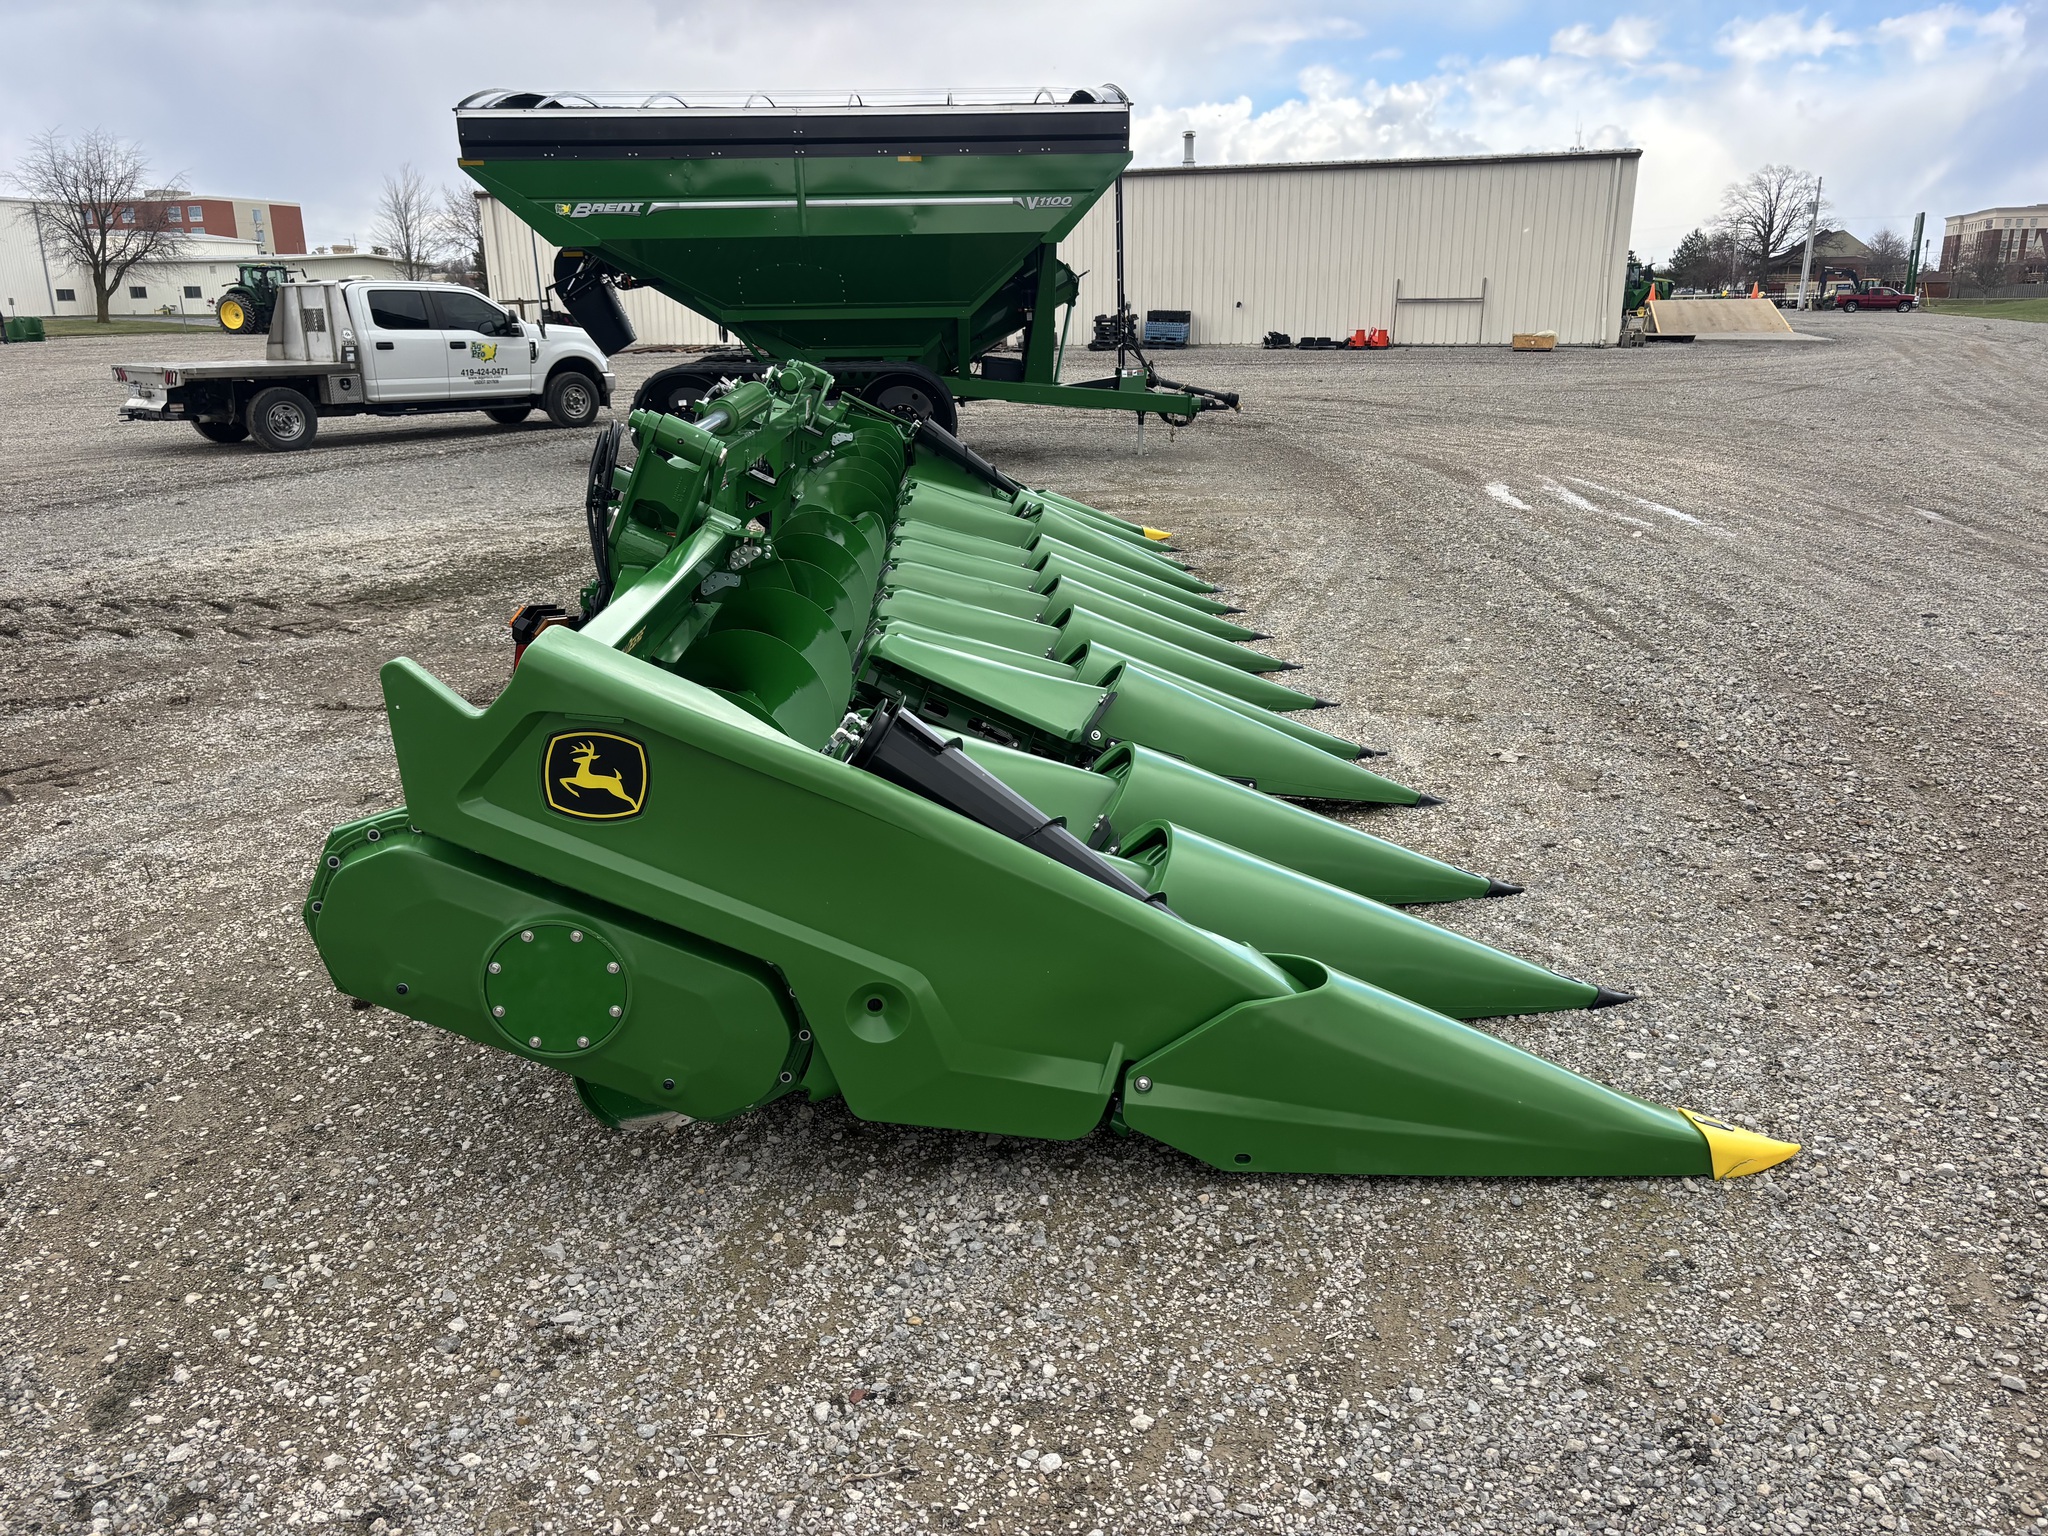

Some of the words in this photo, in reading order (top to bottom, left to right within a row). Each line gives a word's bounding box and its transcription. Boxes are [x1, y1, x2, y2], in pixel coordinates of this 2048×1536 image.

[1026, 196, 1073, 210] V1100
[570, 202, 645, 218] BRENT
[471, 350, 486, 359] Pro
[460, 367, 509, 376] 419-424-0471
